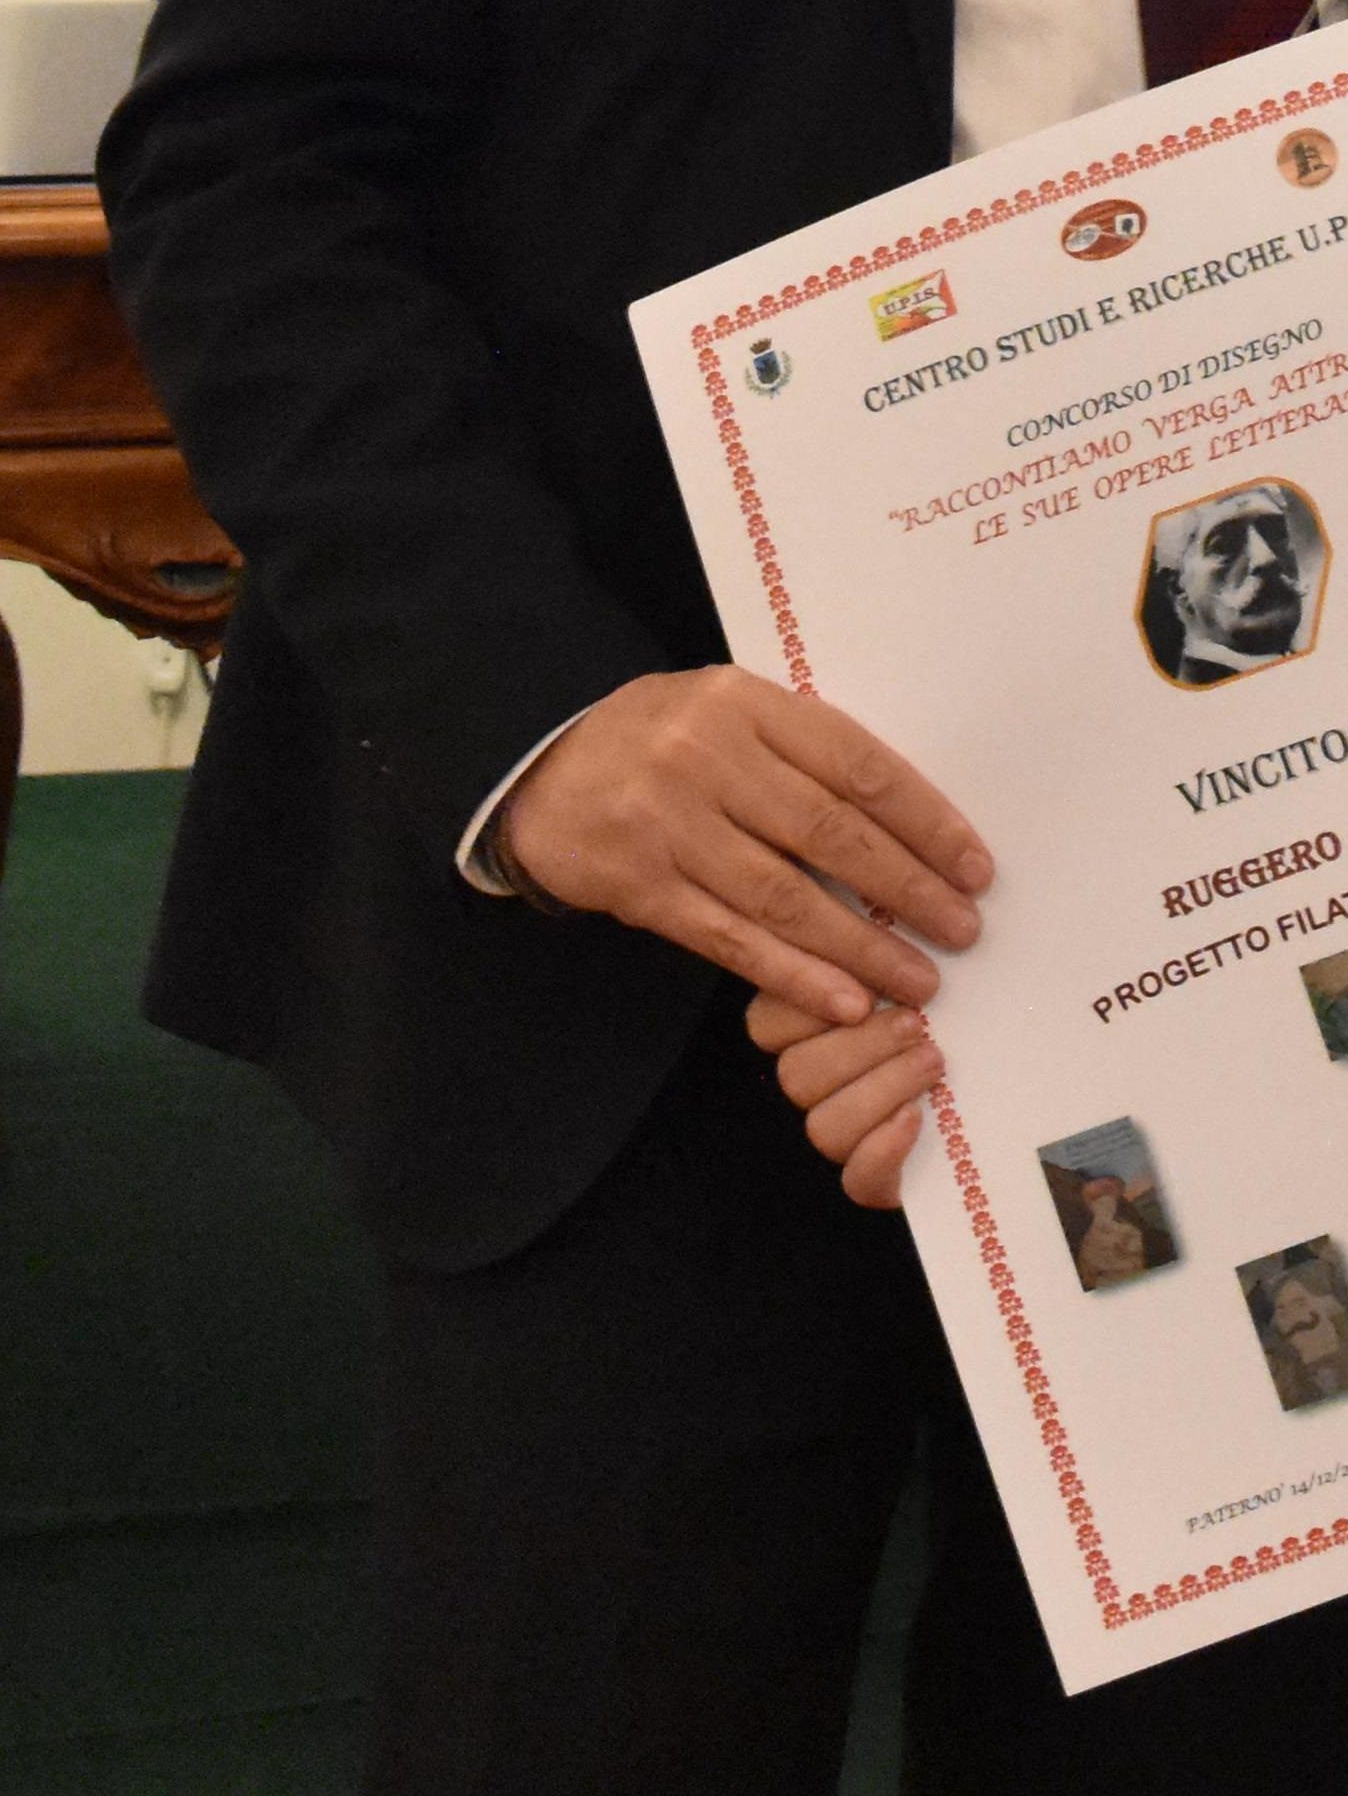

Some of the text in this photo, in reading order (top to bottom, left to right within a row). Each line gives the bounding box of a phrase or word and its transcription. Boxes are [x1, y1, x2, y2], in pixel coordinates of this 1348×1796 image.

[864, 346, 988, 412] CENTRO
[996, 307, 1092, 362] STUDI
[1097, 296, 1124, 325] E
[1127, 235, 1293, 313] RICERCHE
[1006, 318, 1323, 447] CONCORSO DI DISEGNO
[1141, 386, 1256, 440] VERGA
[973, 512, 1009, 545] LE
[1021, 486, 1081, 527] SUE
[1093, 447, 1194, 500] OPERE
[1160, 831, 1342, 918] RUGGERO
[1092, 925, 1270, 1024] PROGETTO
[1185, 1482, 1285, 1534] PATERNO'
